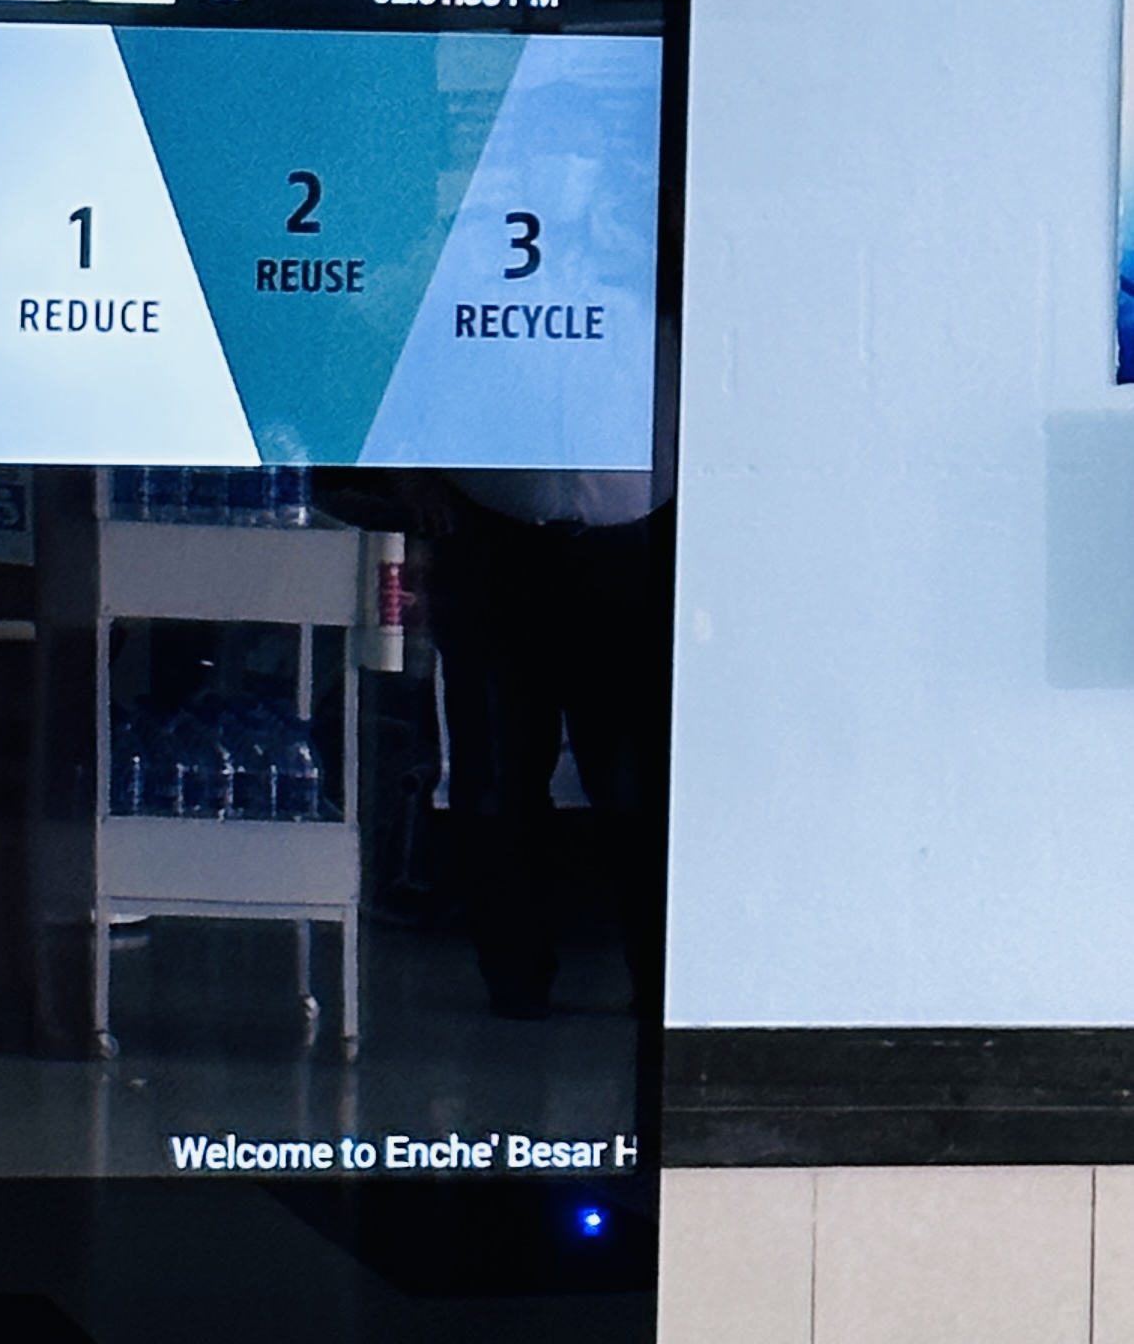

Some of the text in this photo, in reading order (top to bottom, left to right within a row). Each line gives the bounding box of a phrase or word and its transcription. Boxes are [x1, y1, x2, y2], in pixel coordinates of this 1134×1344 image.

[286, 170, 322, 234] 2
[69, 206, 92, 269] 1
[504, 212, 541, 280] 3
[256, 259, 365, 293] REUSE
[20, 299, 161, 333] REDUCE
[455, 304, 604, 339] RECYCLE
[170, 1134, 333, 1169] Welcome
[340, 1138, 376, 1168] to
[385, 1133, 500, 1168] Enche'
[507, 1136, 608, 1168] Besar
